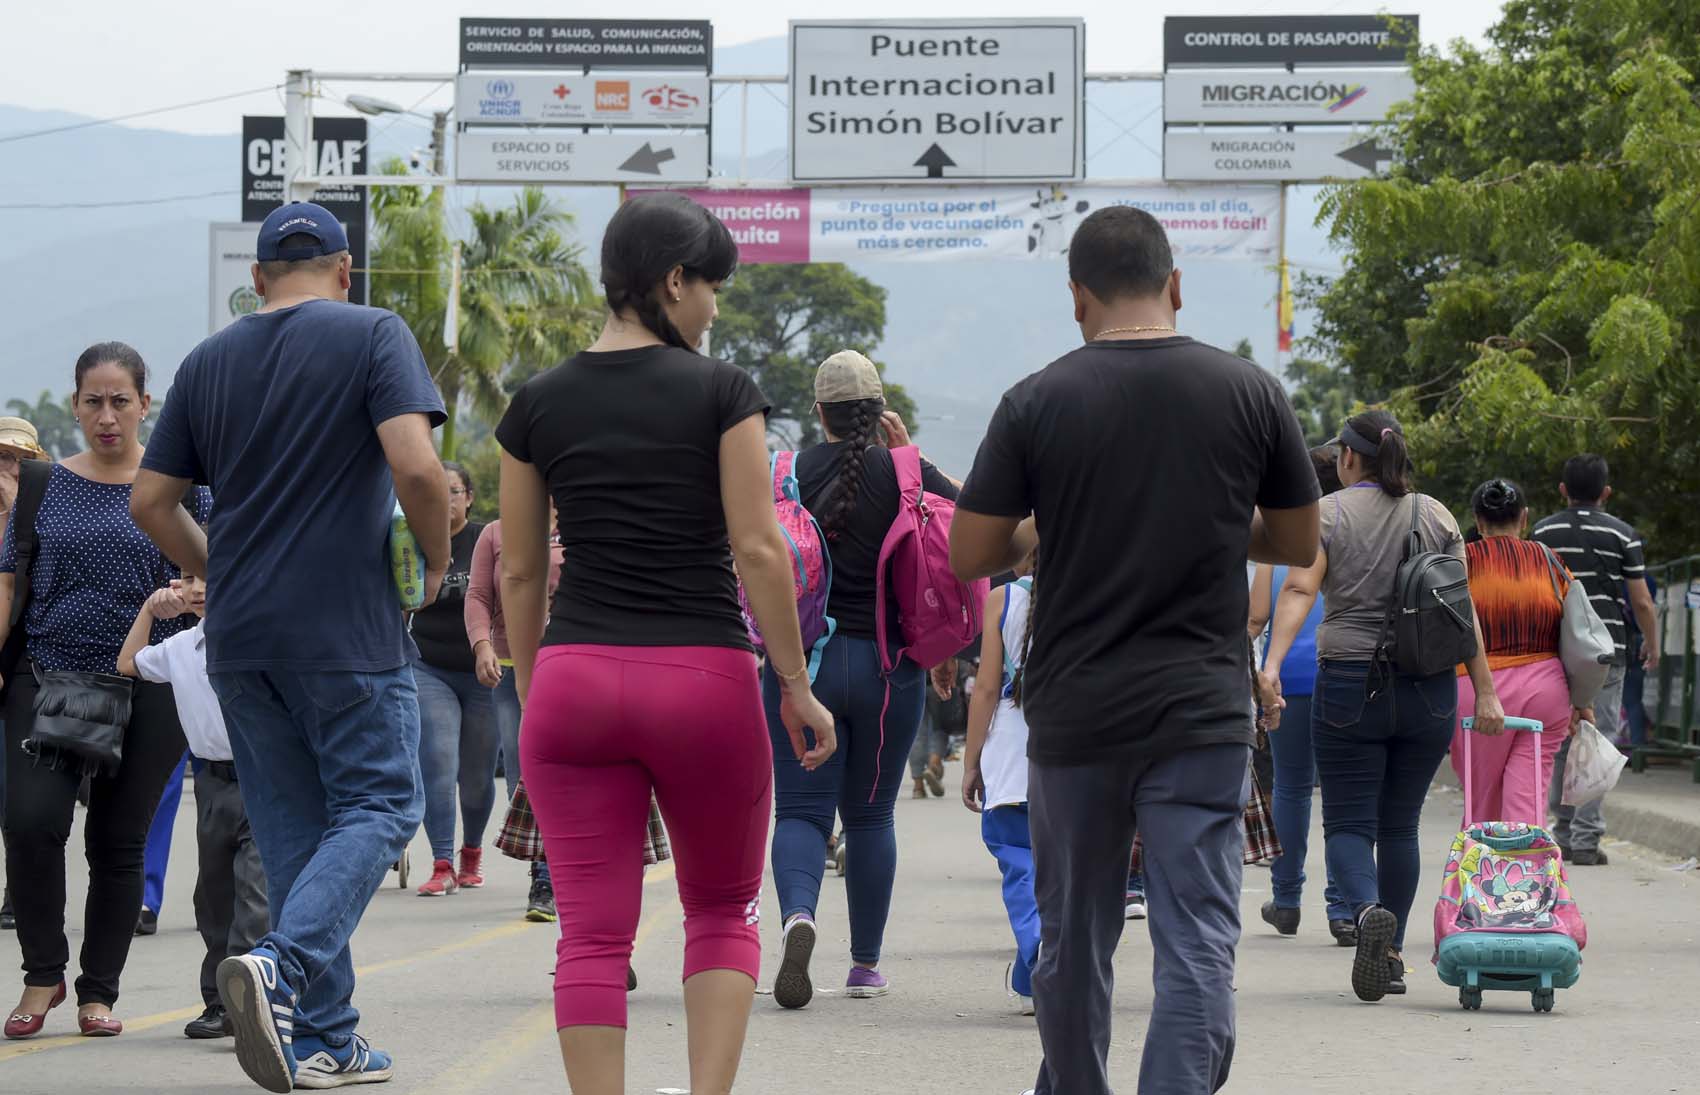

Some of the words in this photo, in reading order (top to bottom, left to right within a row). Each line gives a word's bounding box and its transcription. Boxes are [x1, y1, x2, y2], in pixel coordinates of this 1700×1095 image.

[465, 26, 522, 38] SERVICIO
[528, 27, 545, 38] DE
[551, 27, 595, 40] SALUD,
[601, 27, 705, 41] COMUNICACIÓN,
[1184, 32, 1264, 47] CONTROL
[1268, 32, 1289, 46] DE
[1294, 31, 1390, 46] PASAPORTE
[466, 41, 544, 54] ORIENTACIÓN
[545, 43, 554, 53] Y
[555, 43, 602, 54] ESPACIO
[603, 43, 634, 54] PARA
[635, 43, 651, 54] LA
[652, 43, 706, 55] INFANCIA
[871, 34, 1000, 58] Puente
[809, 72, 1056, 97] Internacional
[1202, 80, 1347, 102] MIGRACIÓN
[479, 99, 521, 109] UNHCR
[596, 92, 628, 106] NRC
[479, 108, 521, 117] ACNUR
[807, 109, 922, 135] Simón
[936, 111, 1064, 135] Bolívar
[491, 142, 551, 154] ESPACIO
[556, 142, 575, 154] DE
[1211, 140, 1295, 153] MIGRACIÓN
[497, 160, 571, 172] SERVICIOS
[1214, 159, 1292, 170] COLOMBIA
[253, 180, 284, 190] CENTR
[708, 202, 801, 221] unación
[943, 200, 975, 216] por
[978, 199, 997, 213] el
[1199, 199, 1216, 213] al
[1219, 199, 1255, 215] día,
[820, 218, 878, 235] punto
[882, 217, 905, 231] de
[911, 215, 1025, 231] vacunación
[1162, 218, 1219, 231] nemos
[1223, 215, 1268, 231] fácil!
[857, 236, 900, 249] más
[903, 236, 989, 249] cercano.
